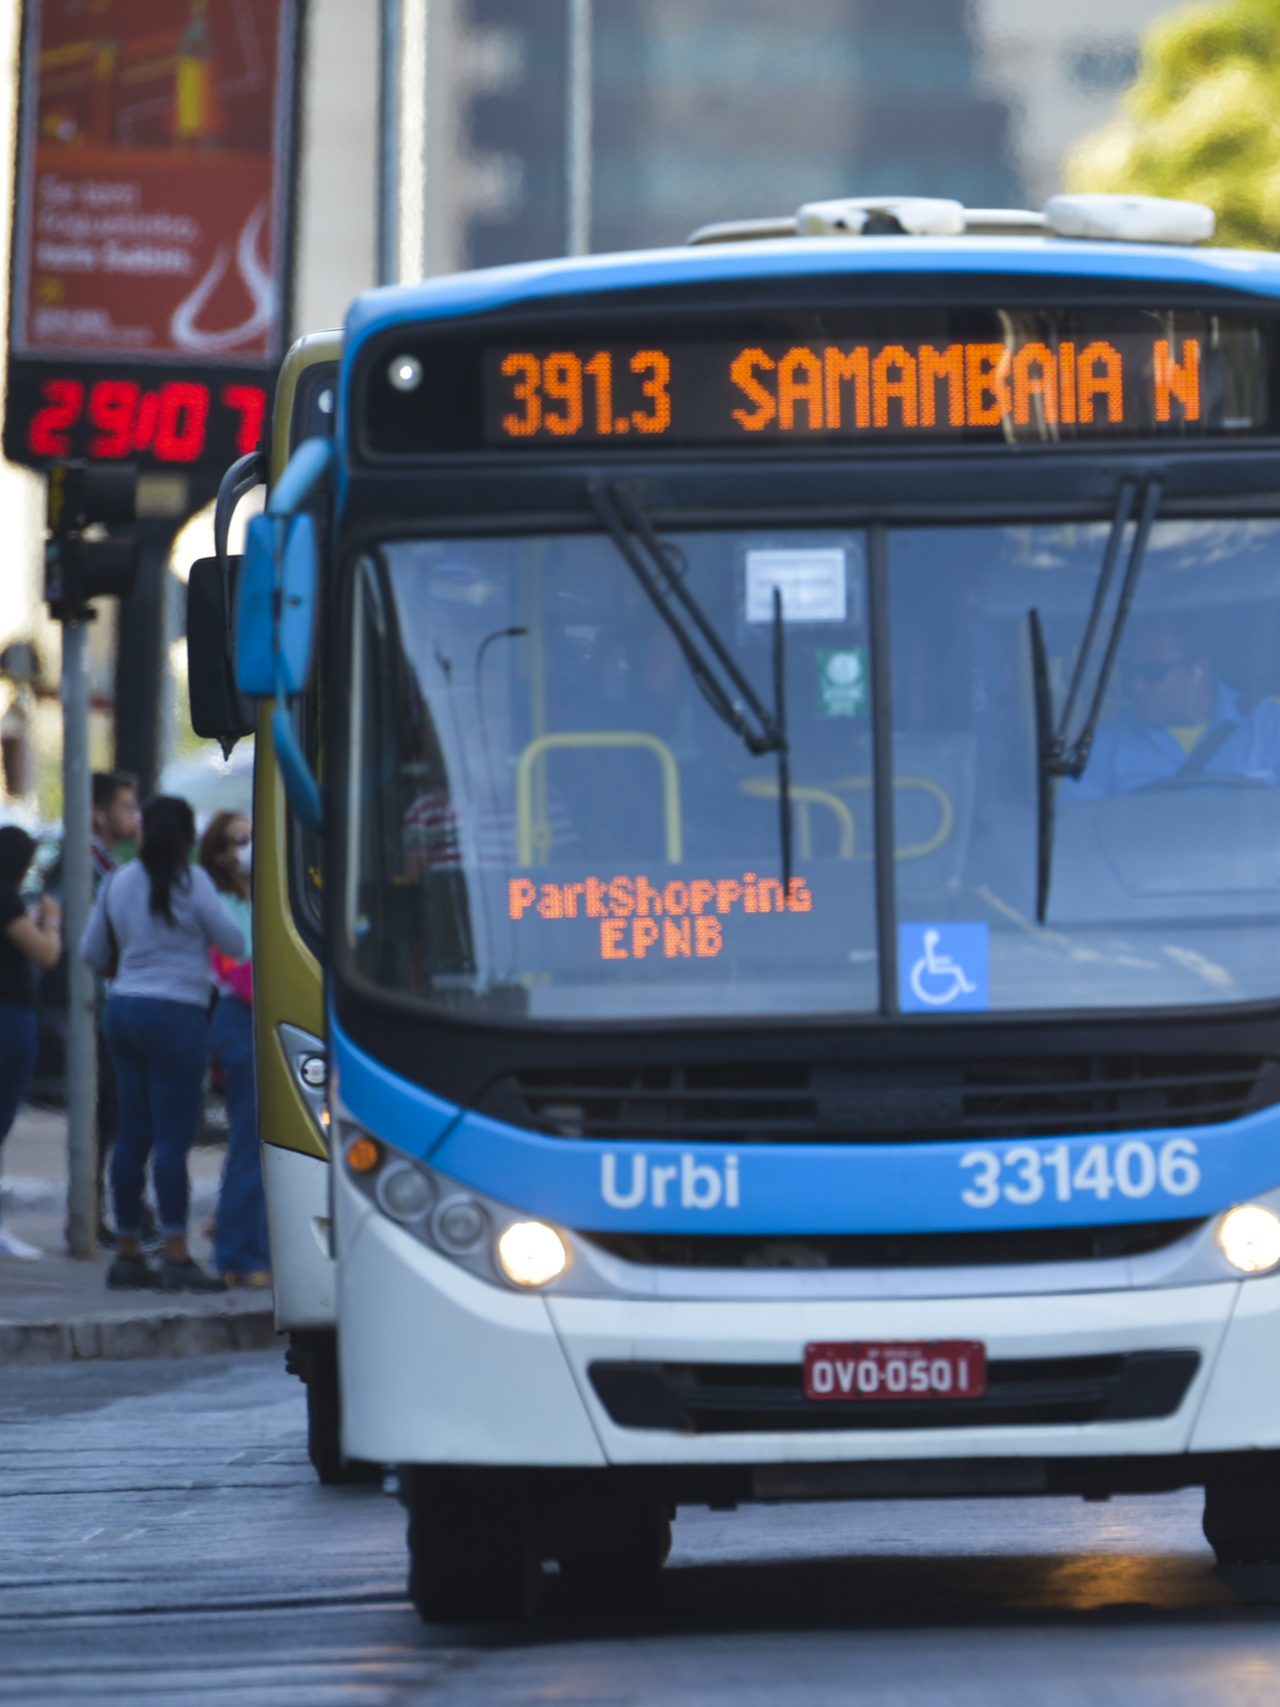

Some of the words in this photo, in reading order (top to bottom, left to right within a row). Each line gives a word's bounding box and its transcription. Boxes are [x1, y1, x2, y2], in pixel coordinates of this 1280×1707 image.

[501, 350, 671, 436] 391.3
[729, 341, 1124, 431] SAMAMBAIA
[1153, 339, 1200, 422] N
[600, 915, 722, 959] EPNB
[601, 1154, 740, 1209] Urbi
[959, 1139, 1200, 1208] 331406
